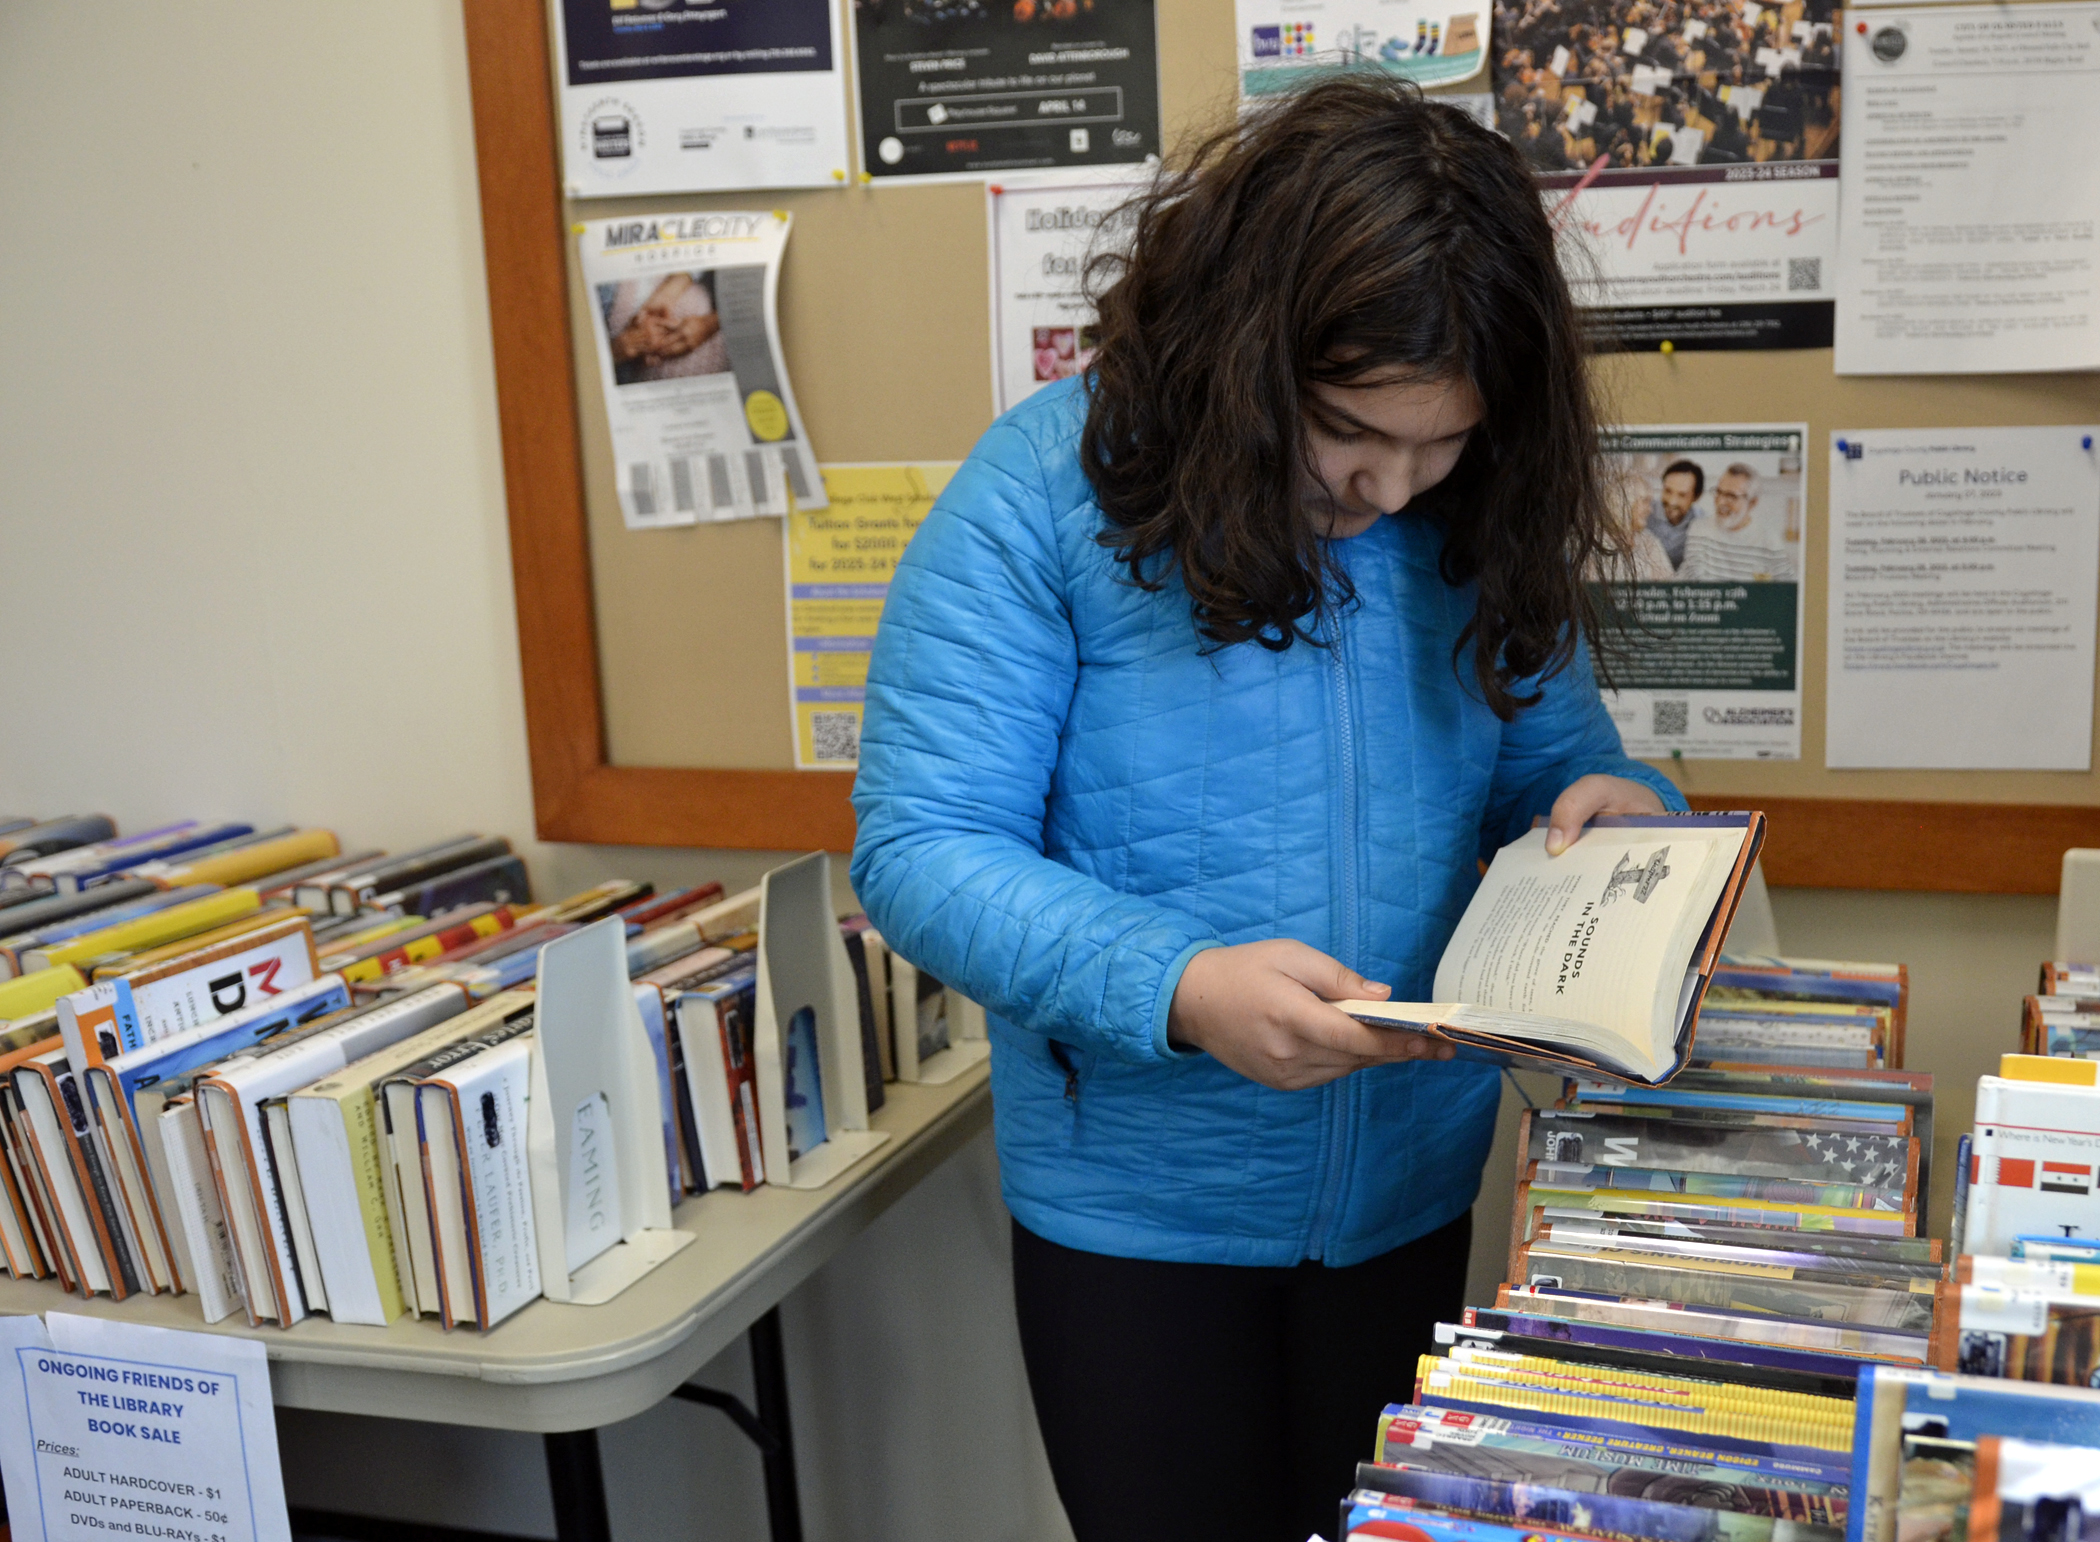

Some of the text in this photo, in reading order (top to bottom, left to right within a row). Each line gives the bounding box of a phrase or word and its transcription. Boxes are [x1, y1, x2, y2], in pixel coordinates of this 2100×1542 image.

[1773, 166, 1820, 179] SEASON
[1622, 434, 1721, 449] Communication
[1899, 467, 2028, 485] Public Notice
[1544, 914, 1560, 943] REACHED
[1555, 902, 1594, 995] IN THE DARK
[1572, 917, 1599, 979] SOUNDS
[209, 971, 248, 1015] D
[1999, 1130, 2092, 1147] Where is New Year's
[483, 1171, 504, 1248] LAUFER,
[38, 1359, 220, 1396] ONGOING FRIENDS OF
[77, 1391, 184, 1418] THE LIBRARY
[88, 1418, 181, 1444] BOOK SALE
[1562, 1430, 1604, 1444] SEEKER
[37, 1439, 80, 1457] Prices:
[1556, 1443, 1643, 1466] MUSEUM
[1606, 1436, 1664, 1452] CREATURE
[1664, 1445, 1714, 1459] BEAKER,
[1651, 1457, 1700, 1476] TIME
[1716, 1452, 1759, 1466] EDISON
[63, 1467, 106, 1483] ADULT
[109, 1474, 195, 1497] HARDCOVER
[206, 1487, 221, 1500] $1
[64, 1490, 106, 1506] ADULT
[110, 1497, 193, 1520] PAPERBACK
[205, 1510, 228, 1525] 50¢
[71, 1513, 105, 1529] DVDs
[108, 1521, 131, 1533] and
[135, 1524, 200, 1542] BLU-RAYs
